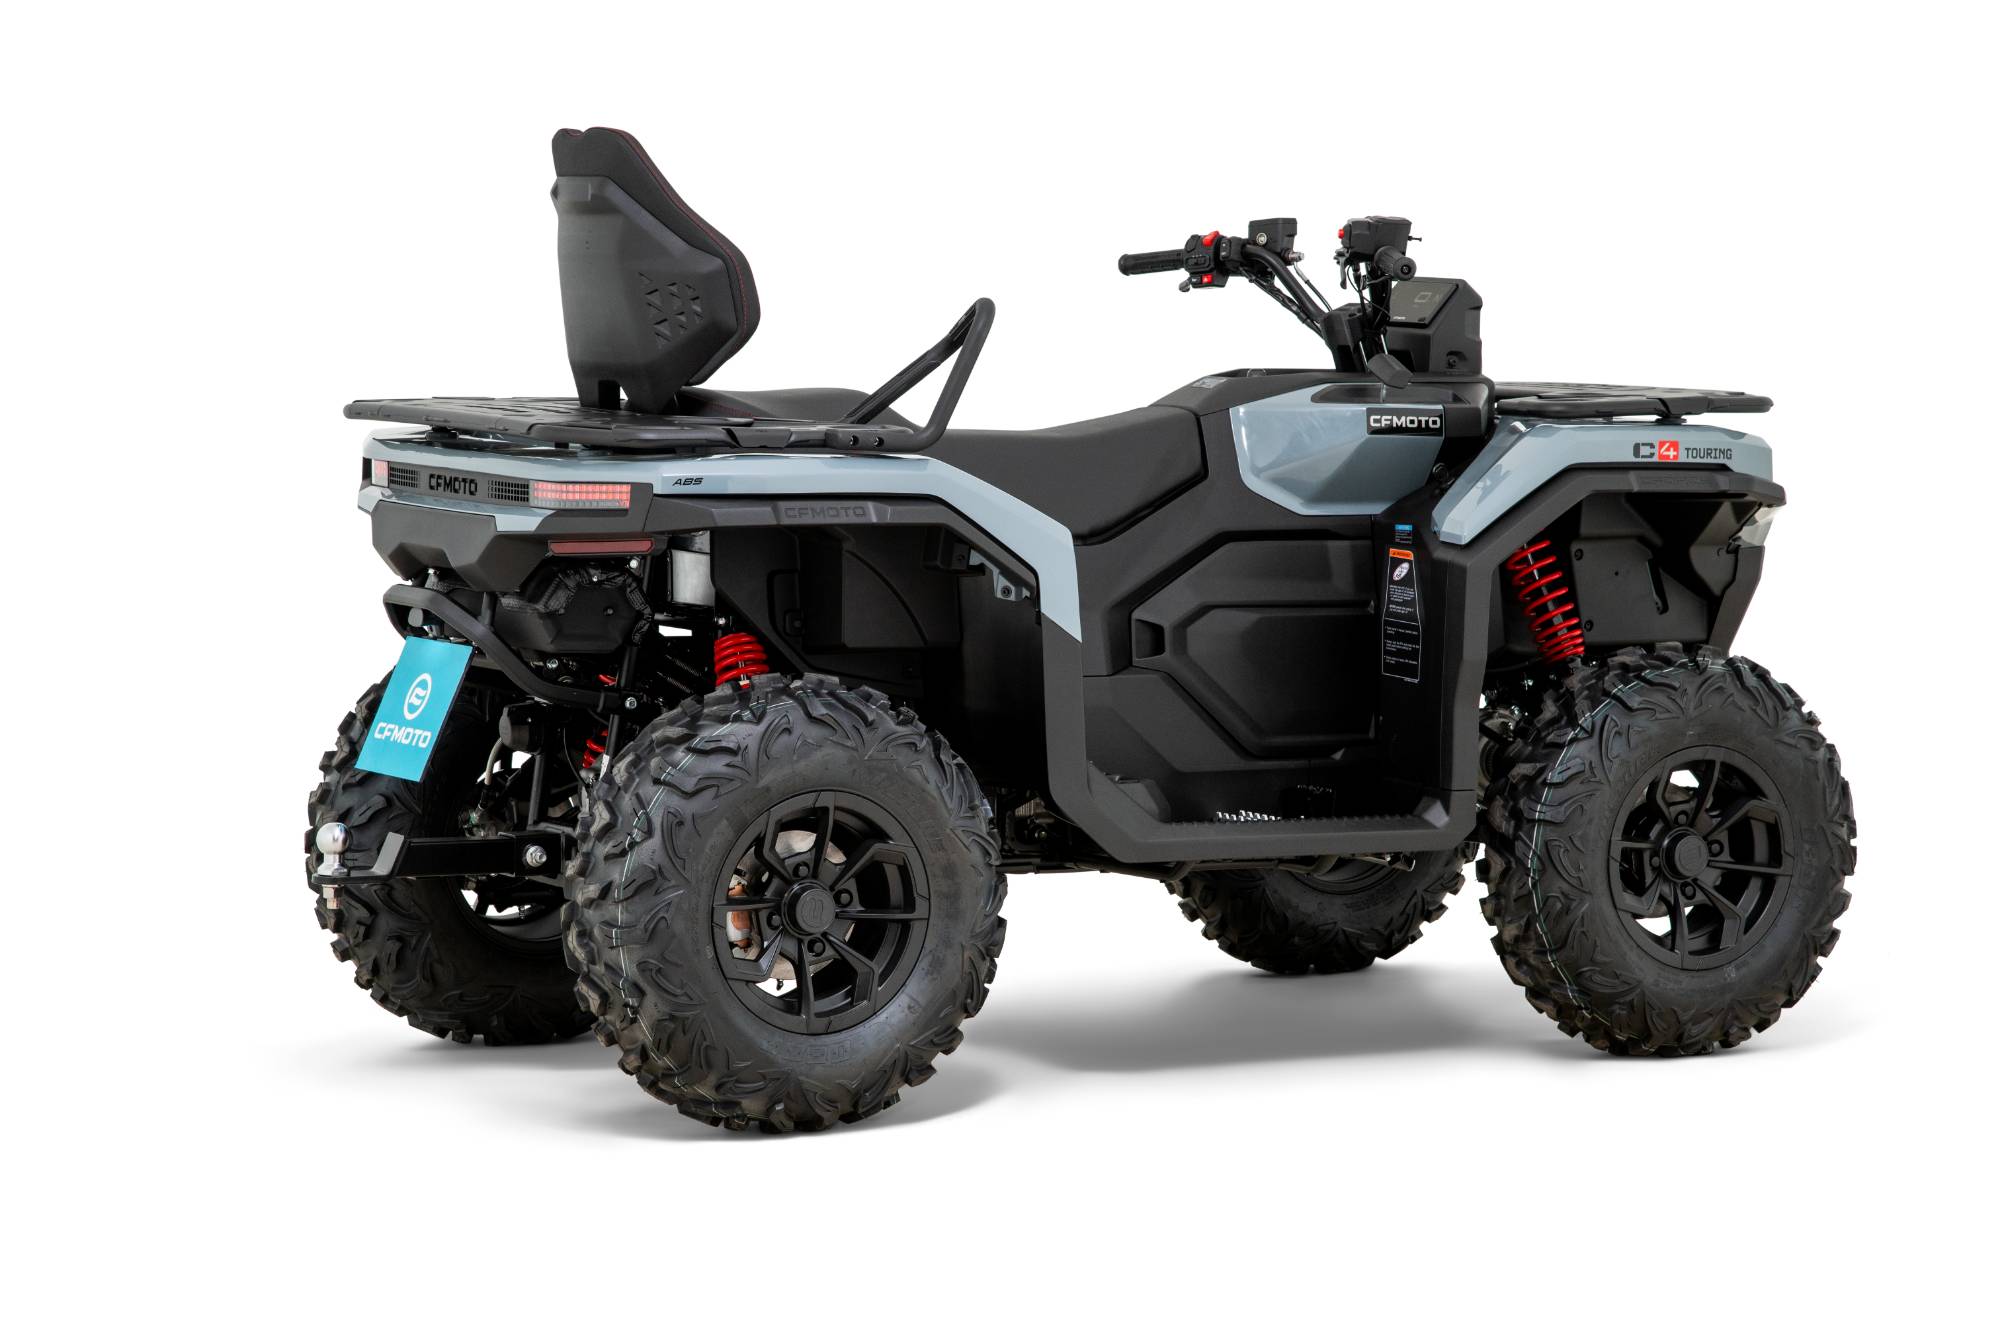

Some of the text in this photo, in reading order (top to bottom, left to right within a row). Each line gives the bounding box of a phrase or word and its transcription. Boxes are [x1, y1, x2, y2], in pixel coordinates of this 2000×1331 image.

[1370, 415, 1440, 429] CFMOTO
[1685, 447, 1733, 460] TOURING
[428, 475, 477, 496] CFMOTO
[672, 477, 704, 486] ABS
[784, 506, 866, 519] CFMOTO
[374, 722, 431, 748] CFMOTO
